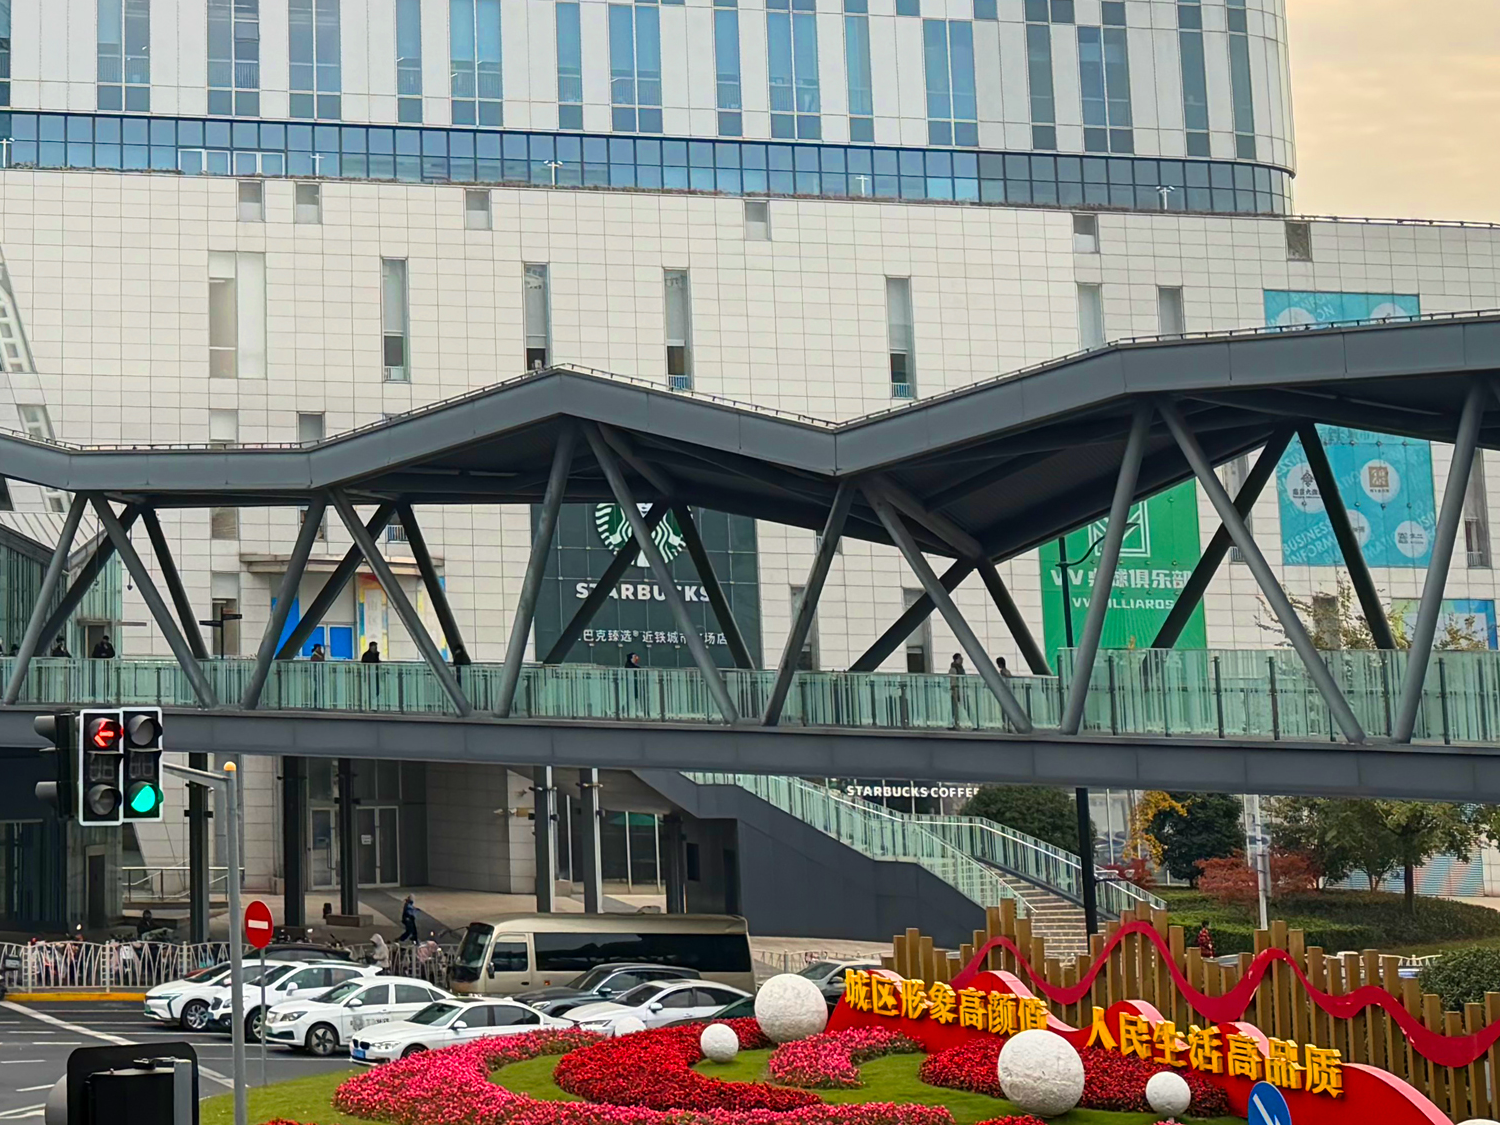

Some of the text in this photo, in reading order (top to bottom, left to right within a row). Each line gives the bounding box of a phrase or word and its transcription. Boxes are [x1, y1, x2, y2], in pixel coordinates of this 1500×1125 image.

[847, 785, 928, 798] STARBUCKS
[845, 968, 1049, 1036] 城区形象高颜值
[1086, 1006, 1345, 1099] 人民生活高品质
